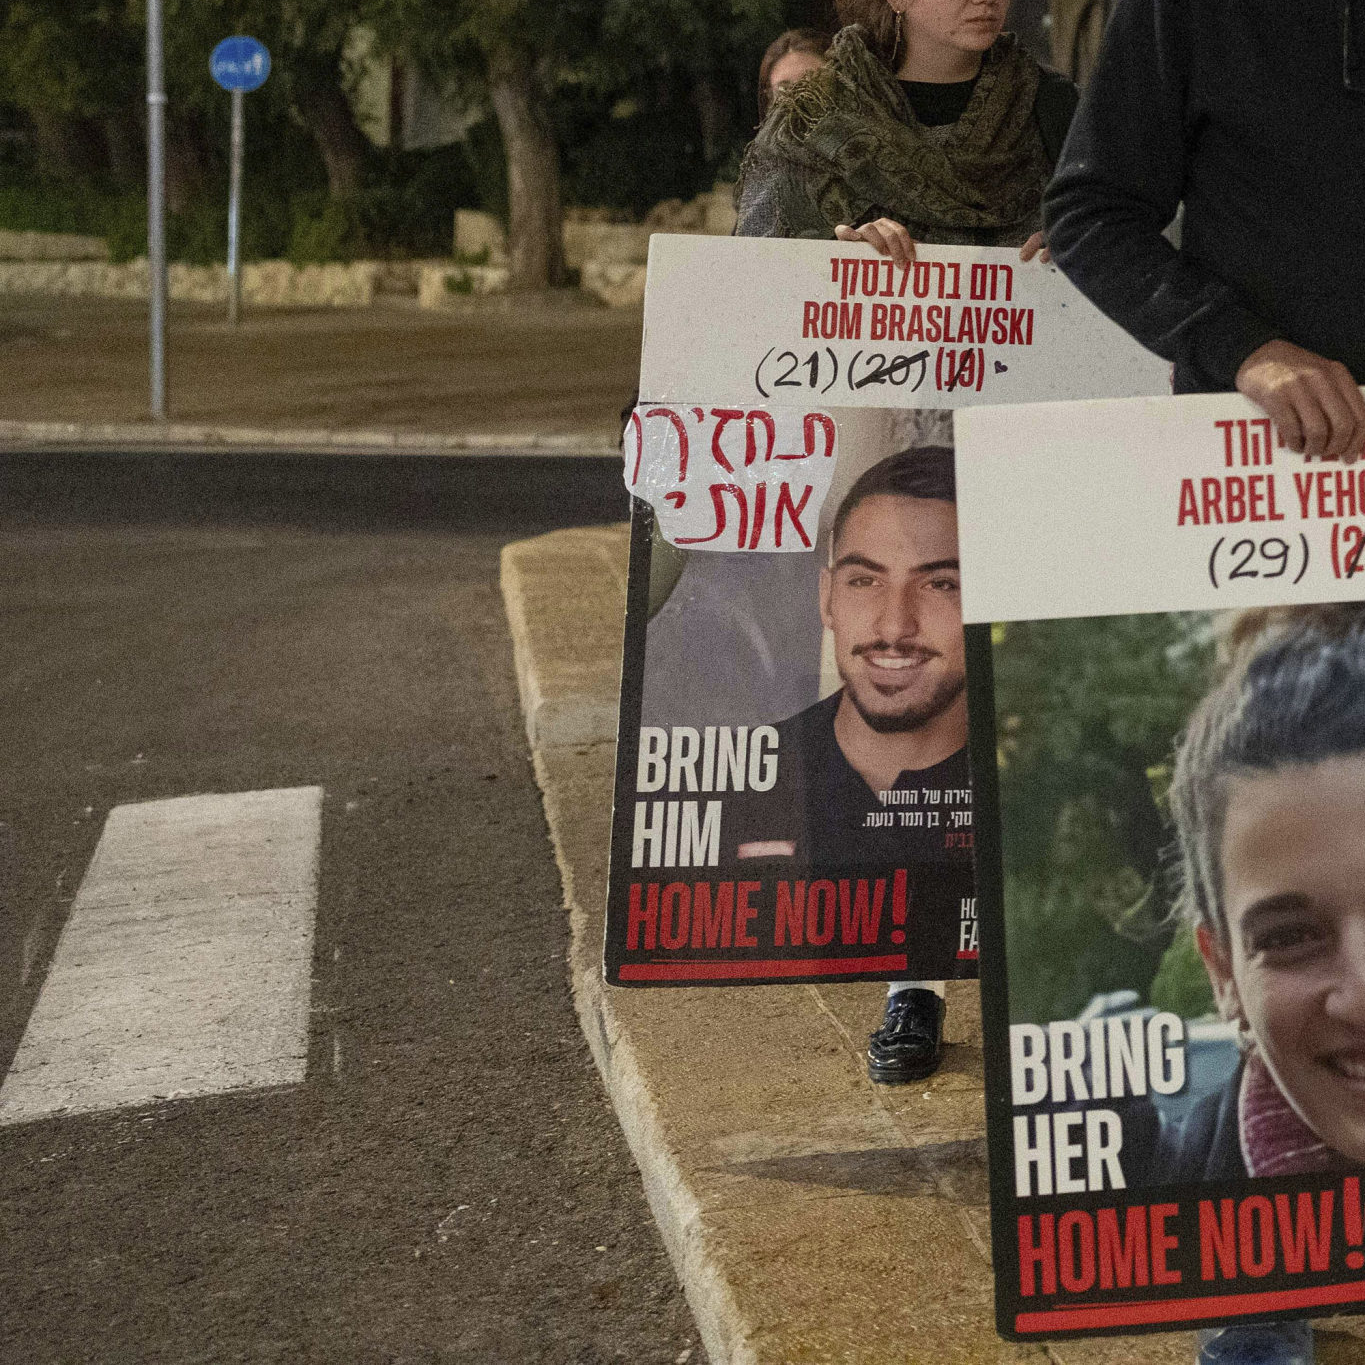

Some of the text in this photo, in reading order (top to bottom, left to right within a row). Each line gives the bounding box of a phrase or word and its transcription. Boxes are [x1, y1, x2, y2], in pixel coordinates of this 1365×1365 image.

[830, 257, 1013, 302] רום ברסלבסקי
[802, 300, 1035, 346] ROM BRASLAVSKI
[754, 346, 839, 398] (21)
[664, 481, 814, 551] אותי
[1178, 474, 1285, 526] ARBEL
[1208, 532, 1310, 589] (29)
[636, 724, 780, 793] BRING
[879, 789, 918, 807] החטוף
[898, 812, 923, 826] תמר
[922, 788, 940, 804] של
[927, 812, 939, 828] בן
[631, 800, 722, 868] HIM
[626, 881, 761, 951] HOME
[773, 869, 908, 947] NOW!
[1009, 1012, 1186, 1106] BRING
[1013, 1109, 1127, 1198] HER
[1018, 1176, 1365, 1297] HOME NOW!
